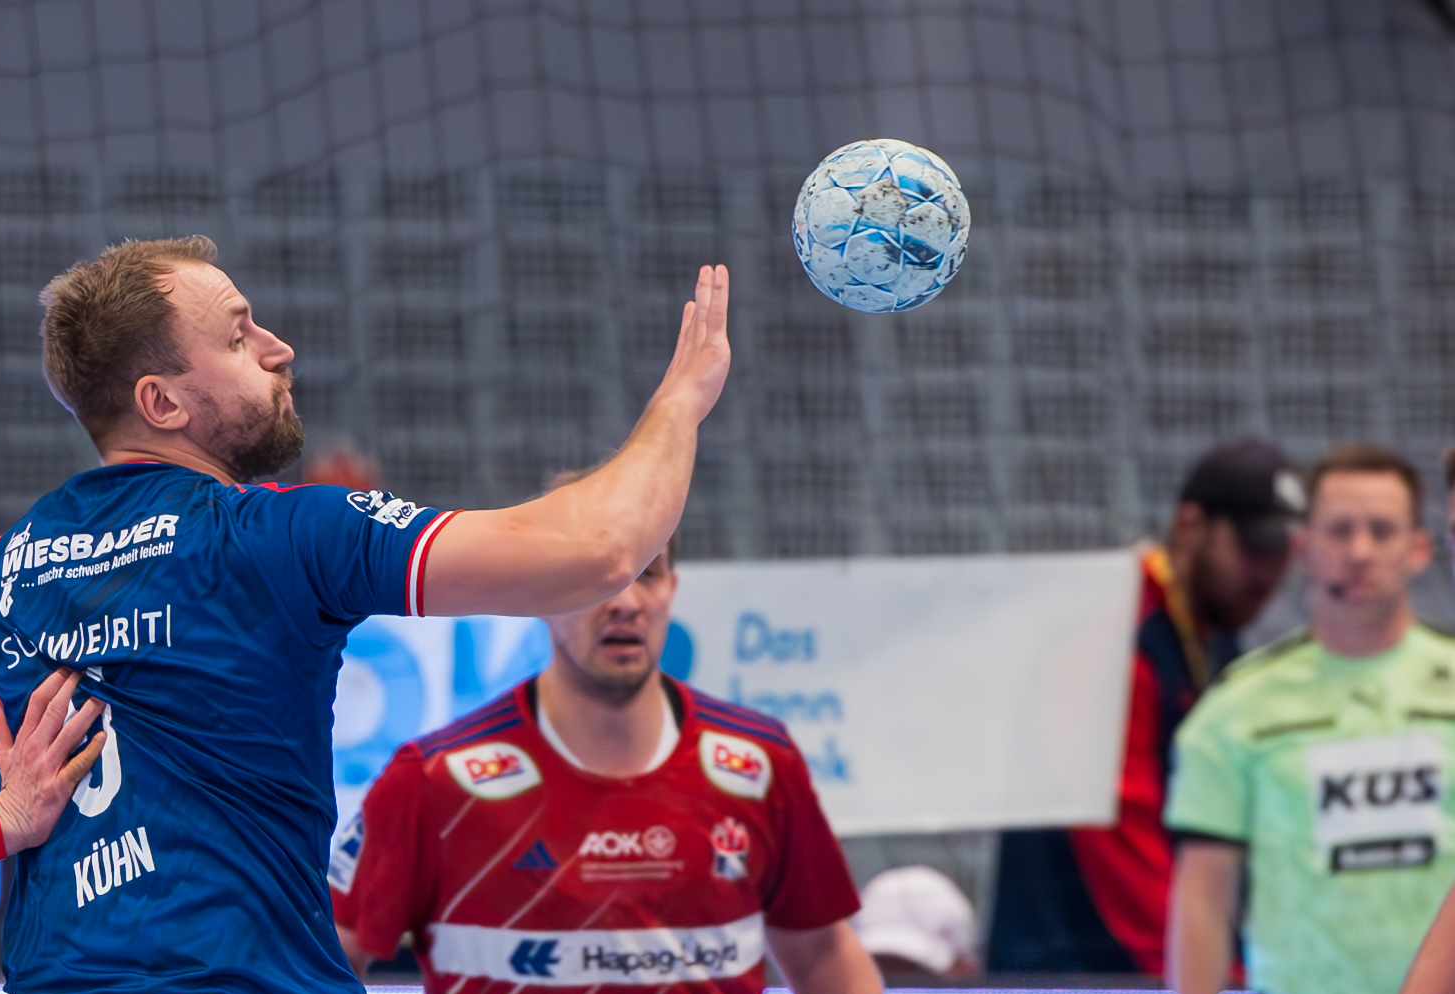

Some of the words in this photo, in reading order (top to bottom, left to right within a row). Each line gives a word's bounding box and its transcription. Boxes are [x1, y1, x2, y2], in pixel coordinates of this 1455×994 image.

[2, 514, 180, 578] WIESBAUER
[37, 566, 64, 586] macht
[65, 560, 110, 579] schwere
[111, 548, 139, 570] Arbeit
[140, 541, 175, 560] leicht!
[73, 826, 156, 909] KÜHN
[579, 831, 644, 857] AOK
